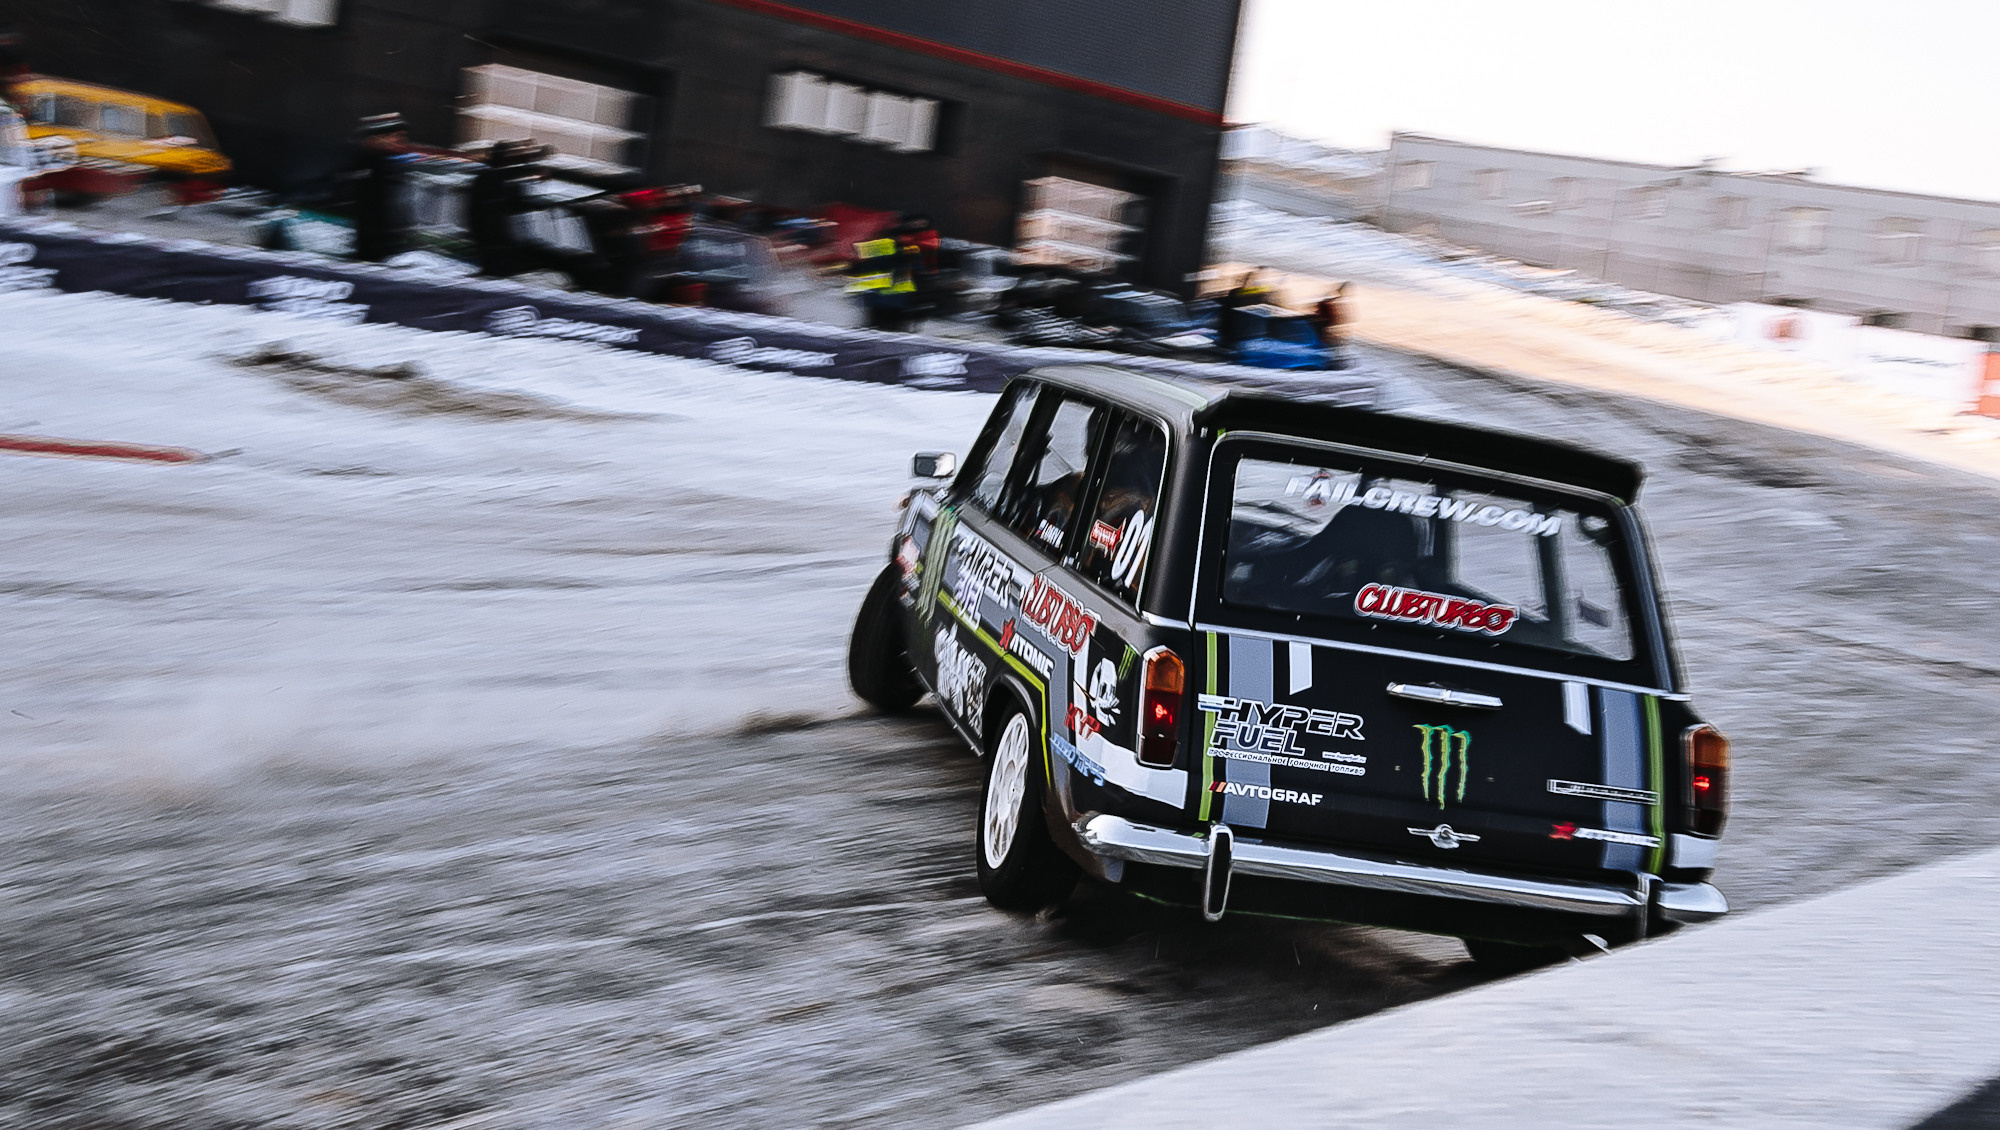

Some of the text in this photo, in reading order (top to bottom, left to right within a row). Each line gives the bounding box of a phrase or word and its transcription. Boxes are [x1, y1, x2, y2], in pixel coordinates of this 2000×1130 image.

[1284, 476, 1562, 537] FAILCREW.COM
[1355, 583, 1519, 635] CLUBTURBO
[1009, 632, 1054, 680] ATOMIC
[1199, 693, 1365, 740] HYPER
[1210, 720, 1305, 757] FUEL
[1207, 747, 1366, 776] ПРОФЕССИОНАЛЬНОЕ ГОНОЧНОЕ ТОПЛИВО
[1223, 782, 1323, 806] AVTOGRAF
